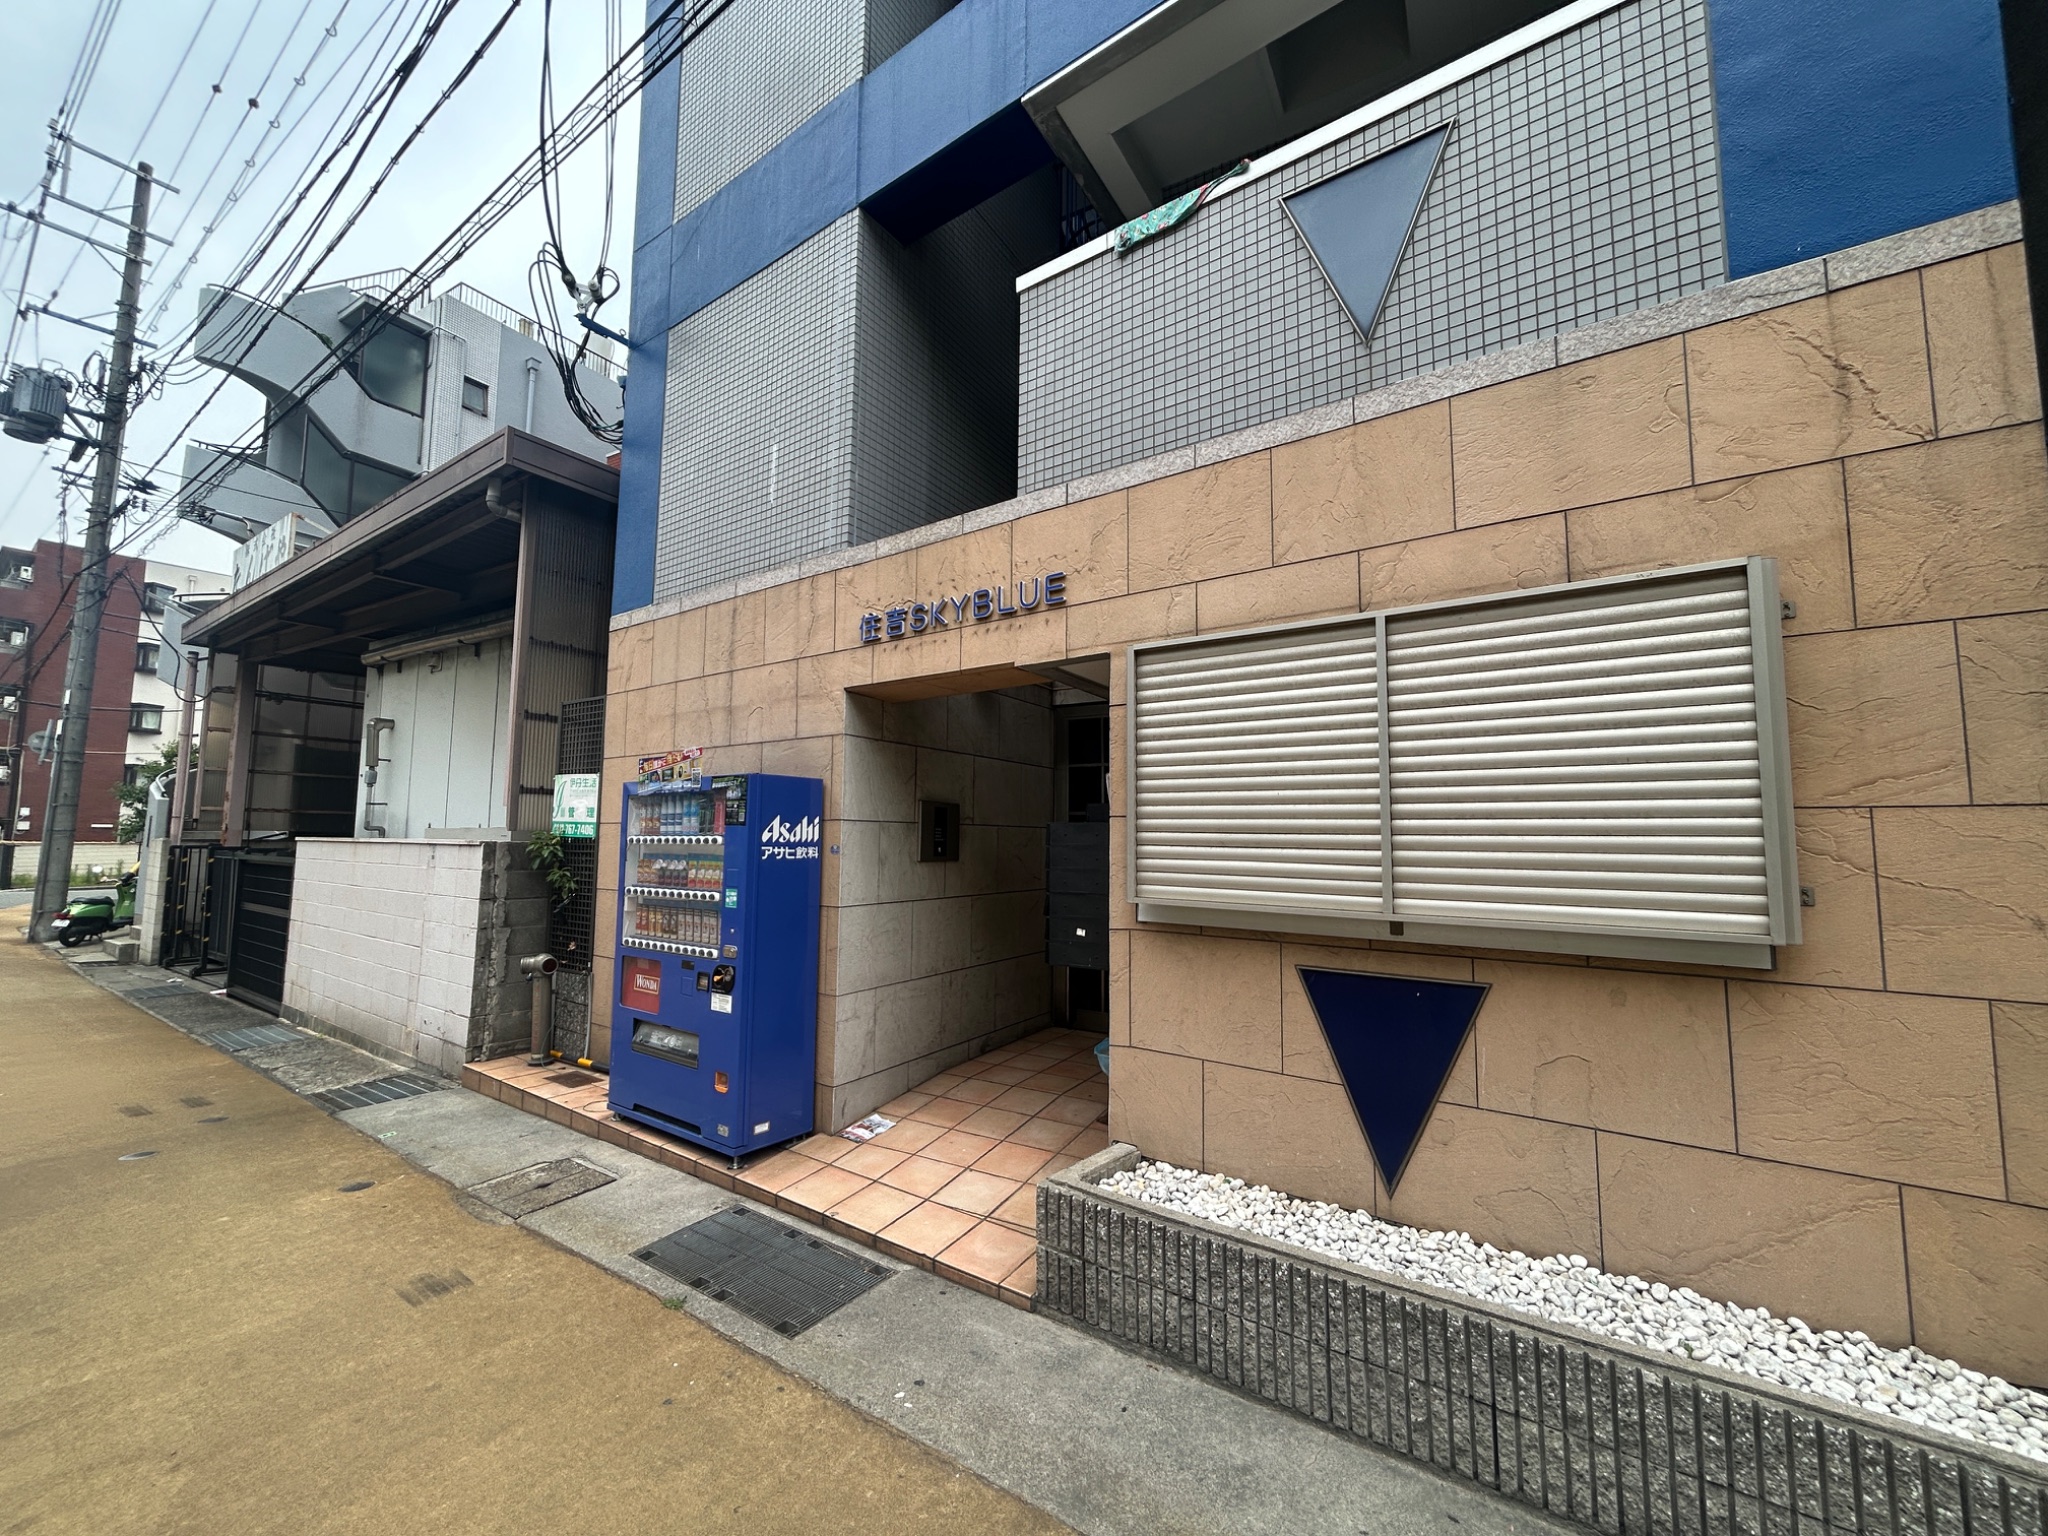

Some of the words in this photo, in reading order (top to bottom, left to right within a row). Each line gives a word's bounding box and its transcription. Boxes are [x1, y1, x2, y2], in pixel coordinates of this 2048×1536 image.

[858, 571, 1067, 643] 住吉SKYBLUE
[761, 815, 820, 843] Asahi
[761, 846, 819, 860] アサヒ飲料
